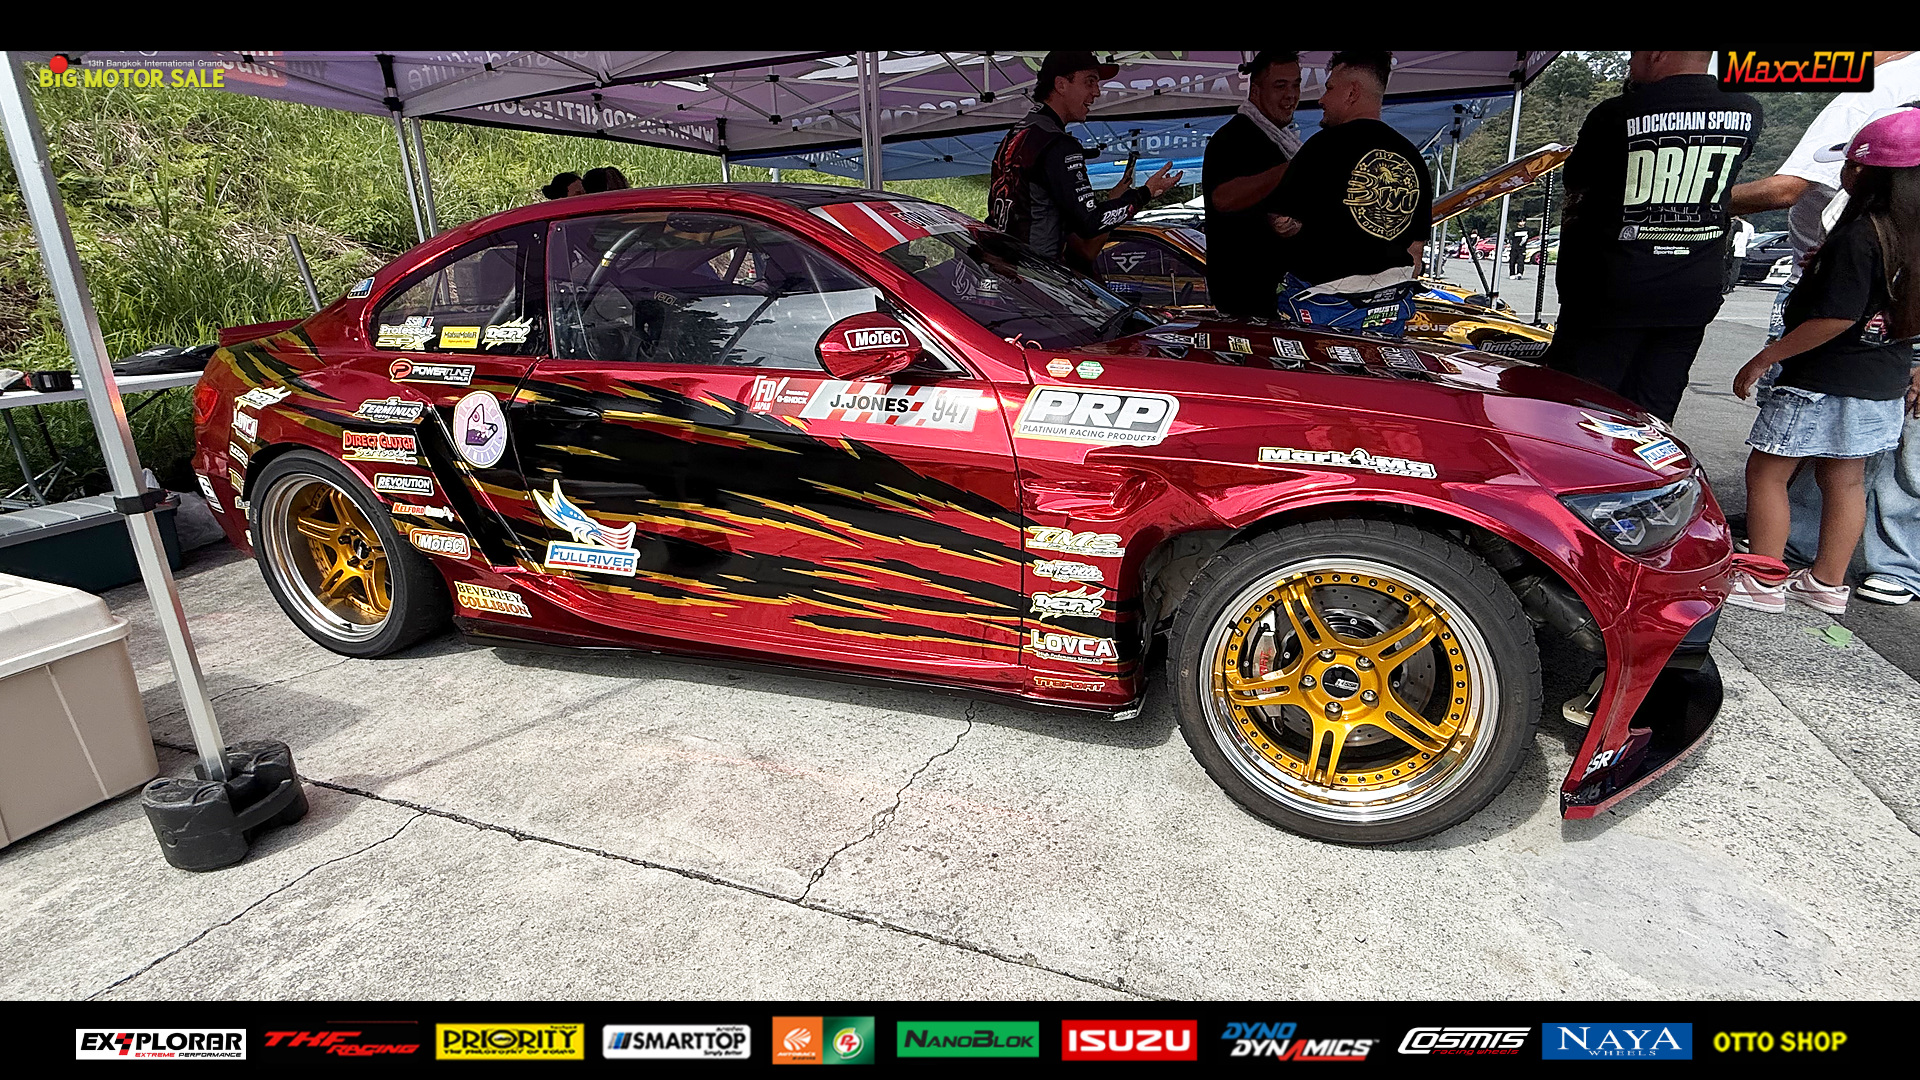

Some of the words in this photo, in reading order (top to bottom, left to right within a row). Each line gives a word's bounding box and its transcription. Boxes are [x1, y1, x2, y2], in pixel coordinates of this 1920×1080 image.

[1627, 112, 1705, 137] BLOCKCHAIN
[1708, 111, 1752, 131] SPORTS
[1623, 146, 1742, 206] DRIFT
[379, 324, 434, 335] Professor
[855, 330, 901, 347] MoTeC
[376, 333, 436, 350] SPX
[360, 404, 420, 418] TERMINUS
[830, 395, 910, 413] J.JONES
[932, 393, 975, 424] 947
[1028, 390, 1168, 430] PRP
[345, 432, 377, 448] DIRECT
[379, 434, 415, 450] CLUTCH
[1022, 425, 1067, 435] PLATINUM
[1069, 428, 1104, 438] RACING
[1107, 432, 1156, 442] PRODUCTS
[378, 476, 430, 489] REVOLUTION
[393, 503, 425, 514] KELFORD
[420, 533, 463, 553] MoTeC
[549, 545, 635, 569] FULLRIVER
[456, 583, 521, 604] BEVERLEY
[458, 594, 530, 616] COLLISION
[1033, 629, 1112, 657] LOVCA
